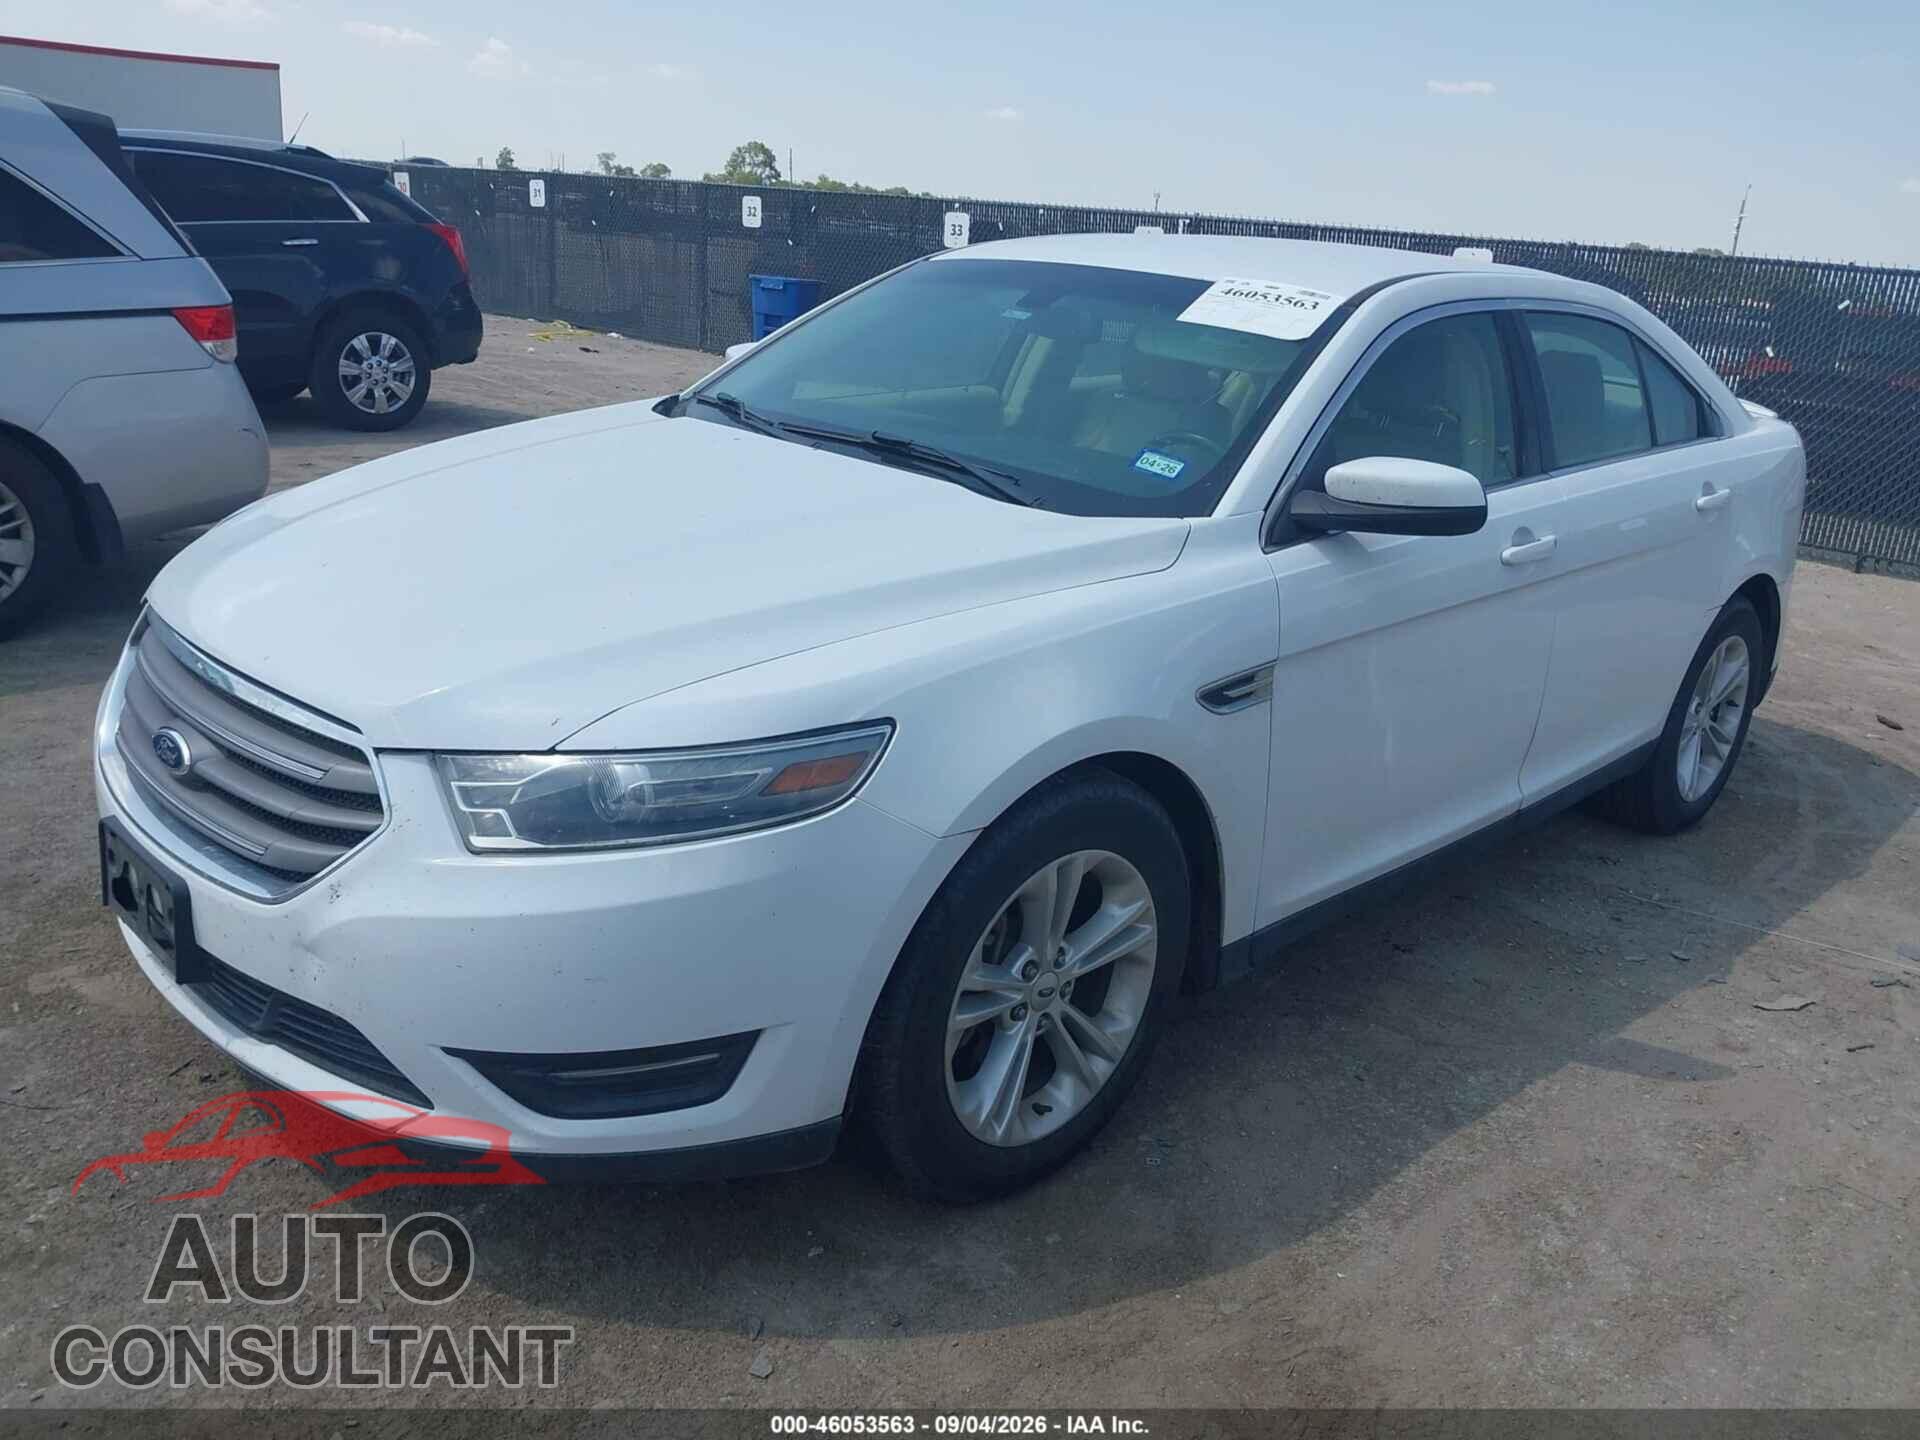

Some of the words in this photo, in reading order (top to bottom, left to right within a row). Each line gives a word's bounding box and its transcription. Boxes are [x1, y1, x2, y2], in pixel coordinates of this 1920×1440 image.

[533, 188, 542, 198] 31
[746, 206, 757, 217] 32
[949, 224, 963, 236] 33
[1220, 287, 1320, 310] 46053563
